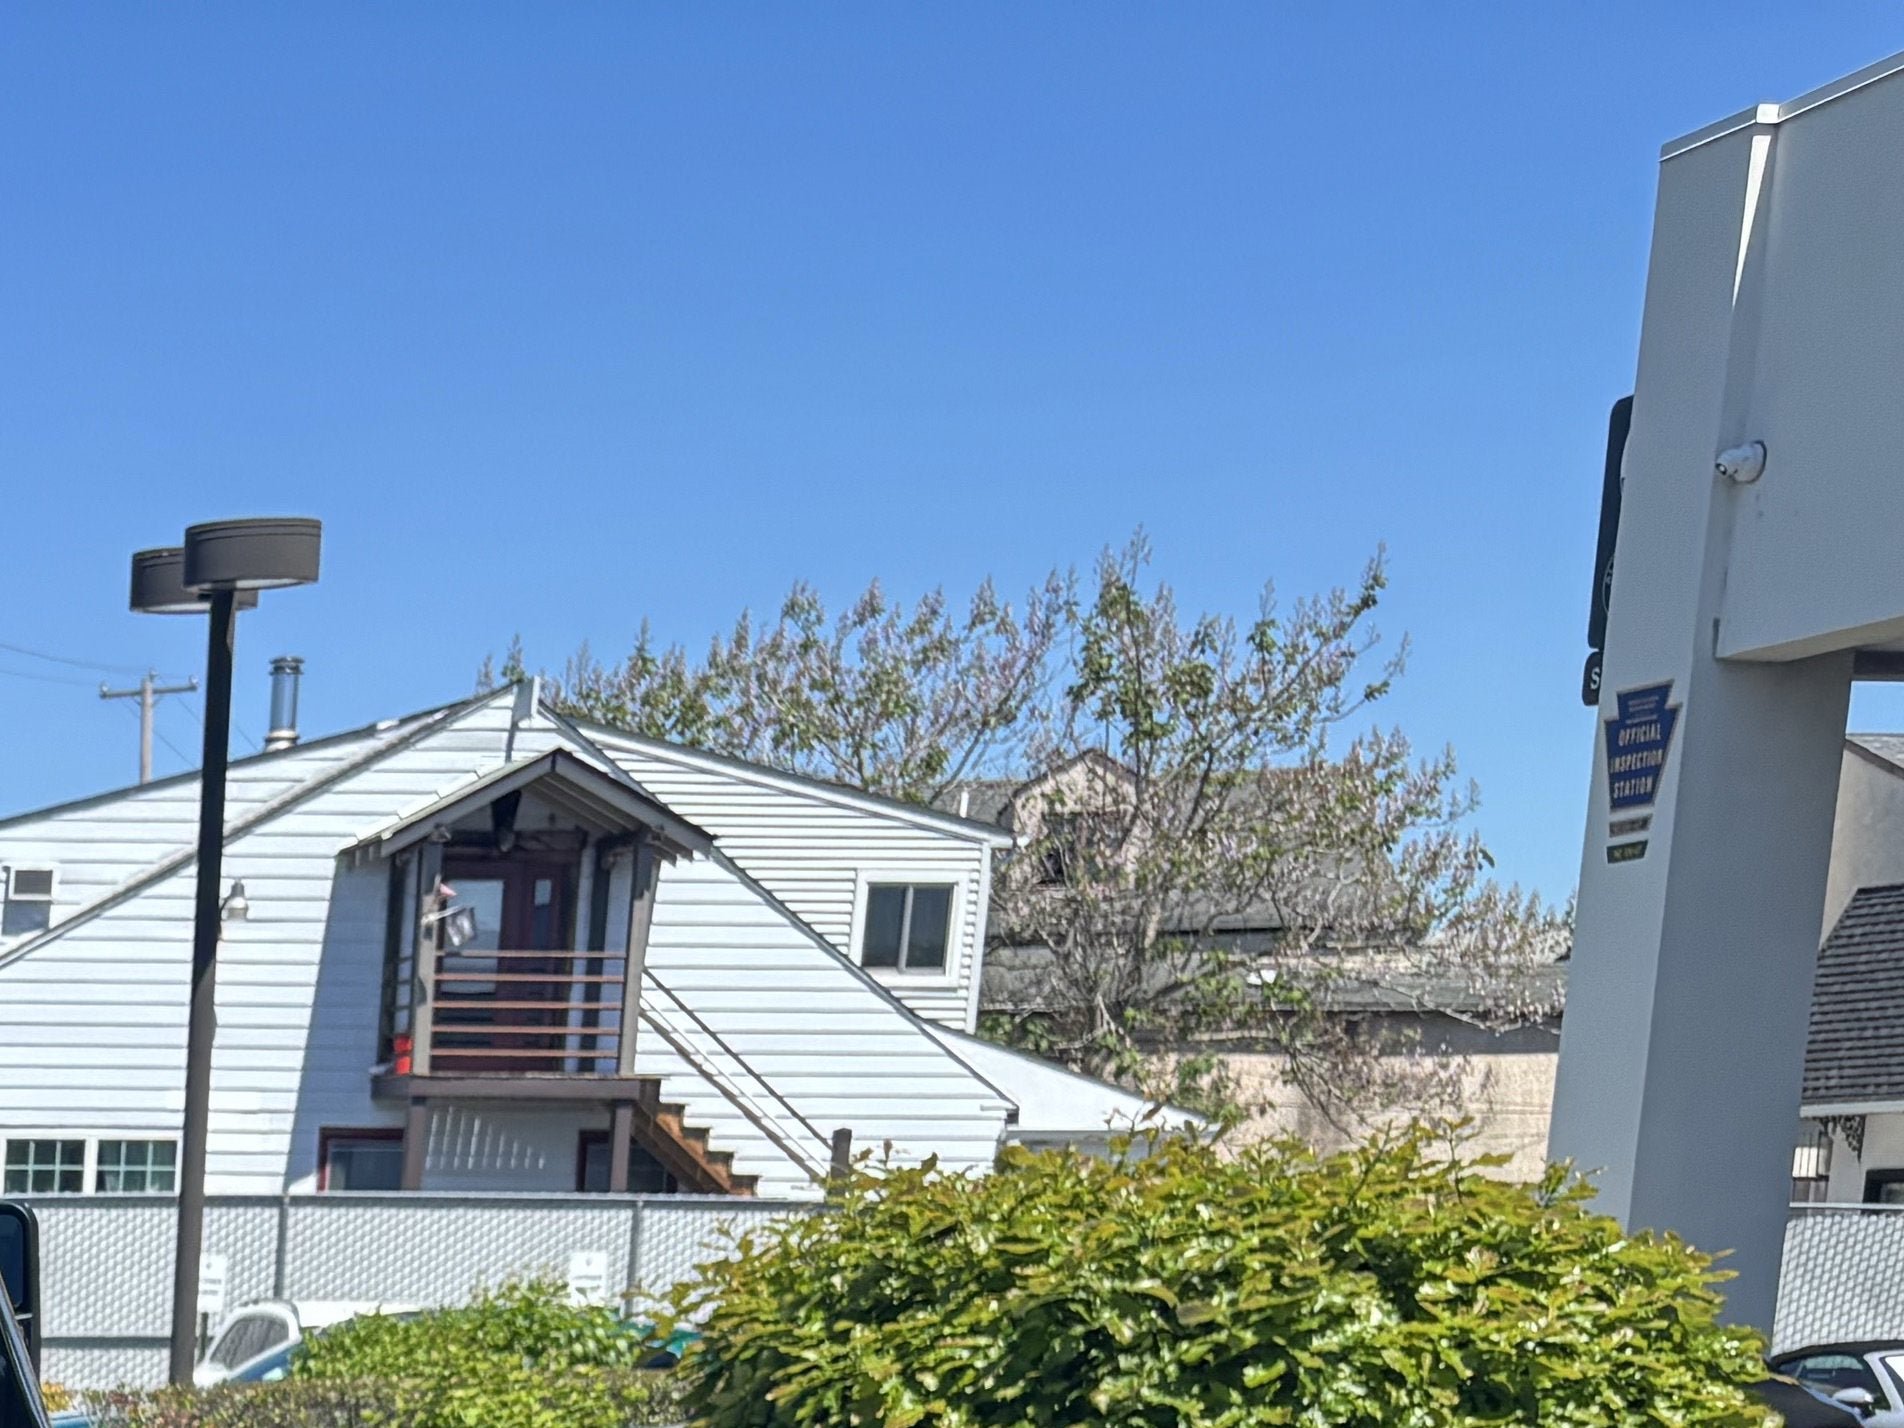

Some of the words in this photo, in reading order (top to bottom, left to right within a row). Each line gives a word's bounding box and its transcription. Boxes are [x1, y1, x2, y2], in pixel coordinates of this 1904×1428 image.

[1618, 722, 1661, 747] OFFICIAL
[1609, 748, 1664, 774] INSPECTION
[1613, 774, 1653, 799] STATION
